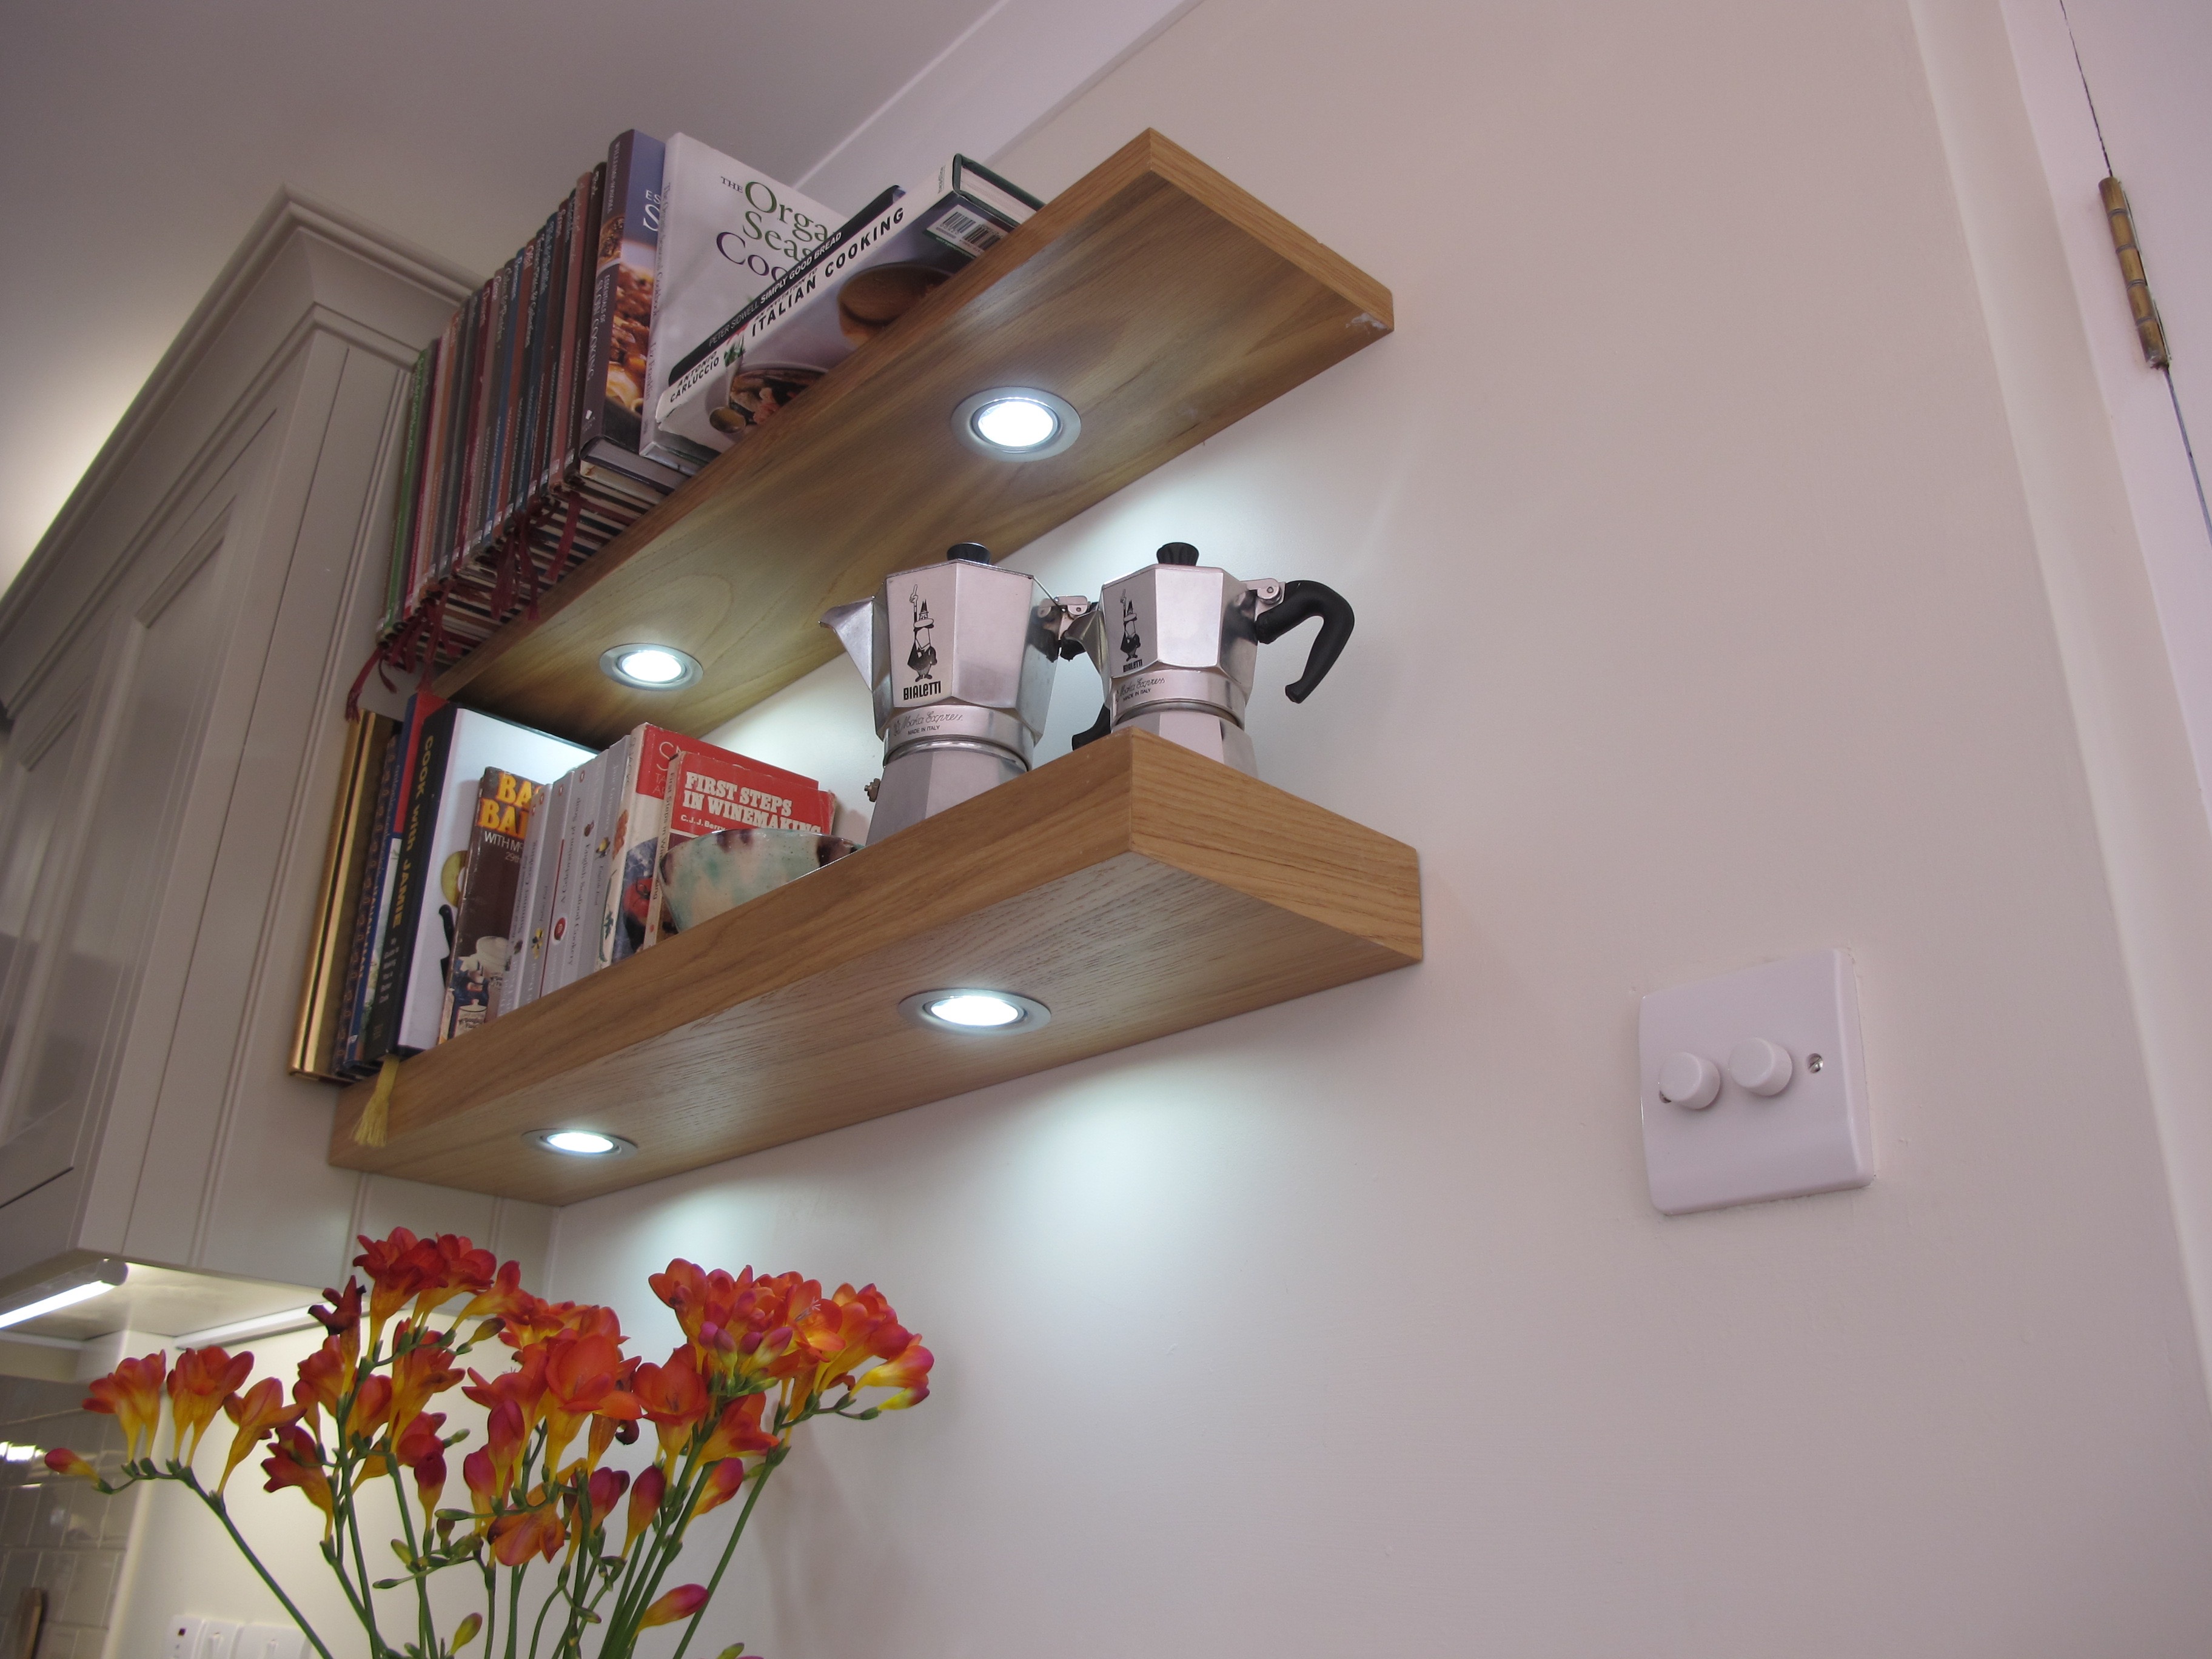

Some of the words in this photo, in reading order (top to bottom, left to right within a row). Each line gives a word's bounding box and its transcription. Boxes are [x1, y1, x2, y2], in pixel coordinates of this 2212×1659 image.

[720, 176, 743, 193] THE
[745, 181, 830, 242] Orga
[716, 232, 788, 282] Coo
[752, 275, 817, 337] ITALIAN
[825, 207, 904, 278] COOKING
[709, 324, 730, 347] PETER
[731, 301, 760, 329] SIDWELL
[760, 275, 788, 304] SIMPLY
[789, 256, 813, 280] GOOD
[814, 232, 842, 260] BREAD
[587, 318, 599, 381] COOKING
[677, 350, 717, 388] ANTONIO
[670, 357, 720, 403] CARLUCCIO
[1136, 677, 1165, 688] Express
[416, 735, 434, 800] COOK
[663, 796, 672, 823] Steps
[682, 789, 705, 811] IN
[685, 771, 737, 801] FIRST
[739, 786, 793, 817] STEPS
[484, 830, 510, 850] WITH
[662, 826, 666, 835] in
[392, 859, 412, 930] JAMIE
